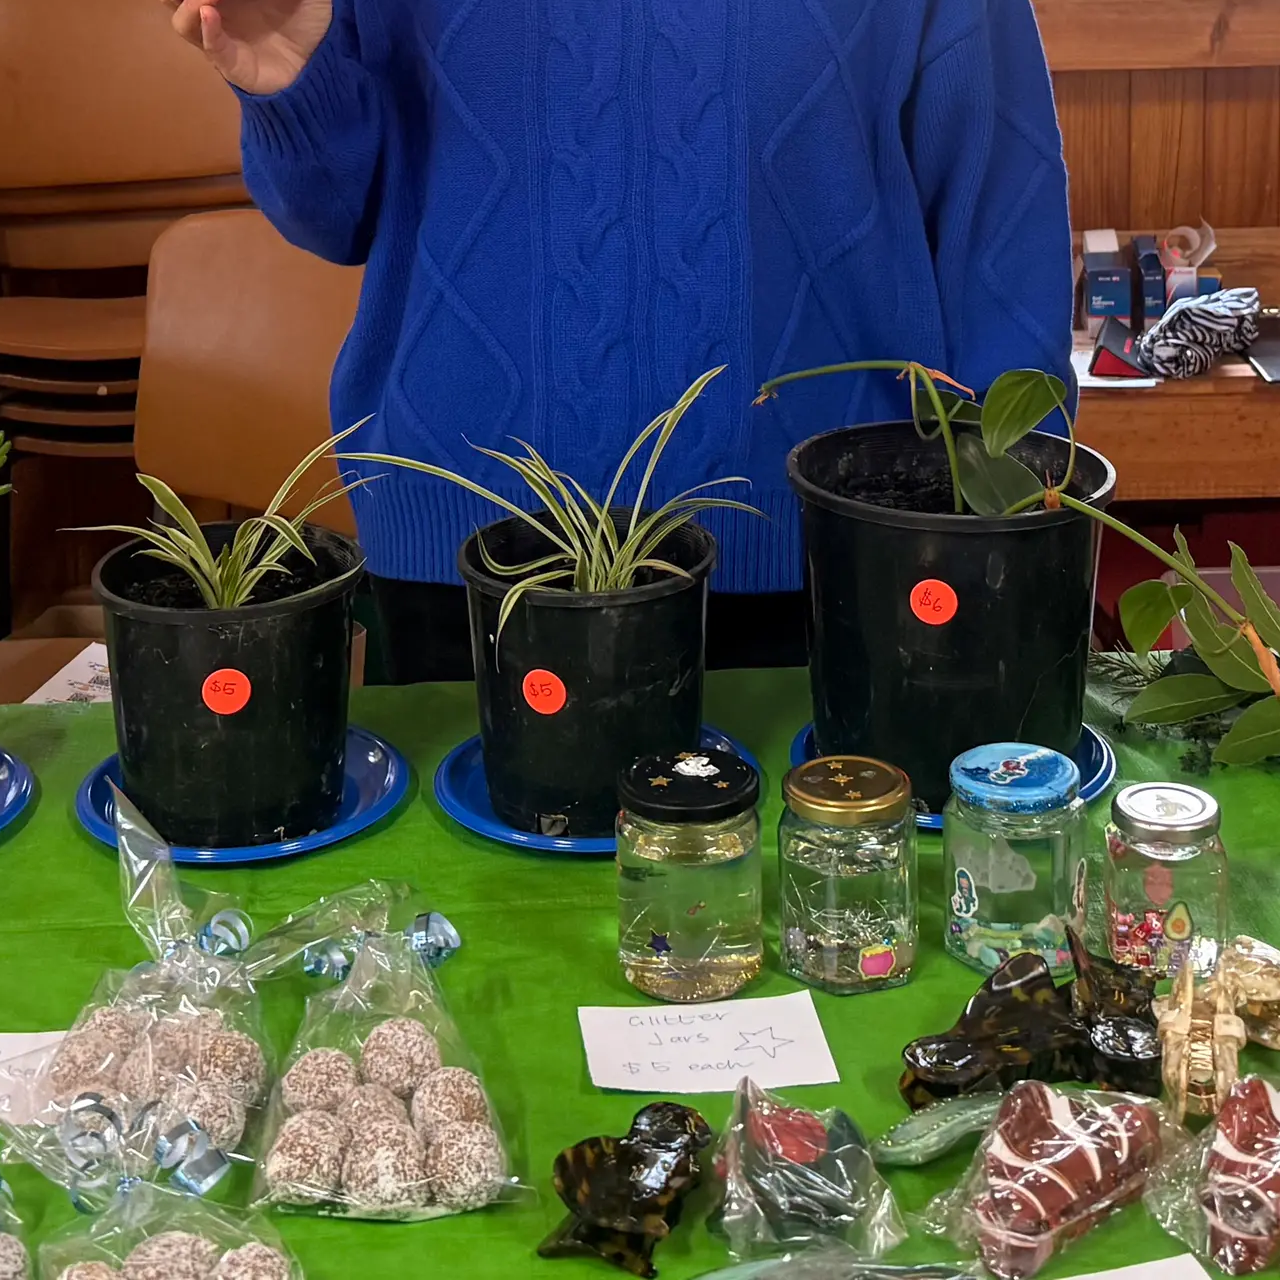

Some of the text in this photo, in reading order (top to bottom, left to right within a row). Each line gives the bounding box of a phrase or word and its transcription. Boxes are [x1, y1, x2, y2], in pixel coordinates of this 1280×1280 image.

[918, 589, 943, 613] $6
[210, 680, 236, 697] $5
[528, 681, 552, 699] $5
[628, 1011, 730, 1027] Glitter
[648, 1032, 710, 1046] Jars
[689, 1059, 755, 1071] each
